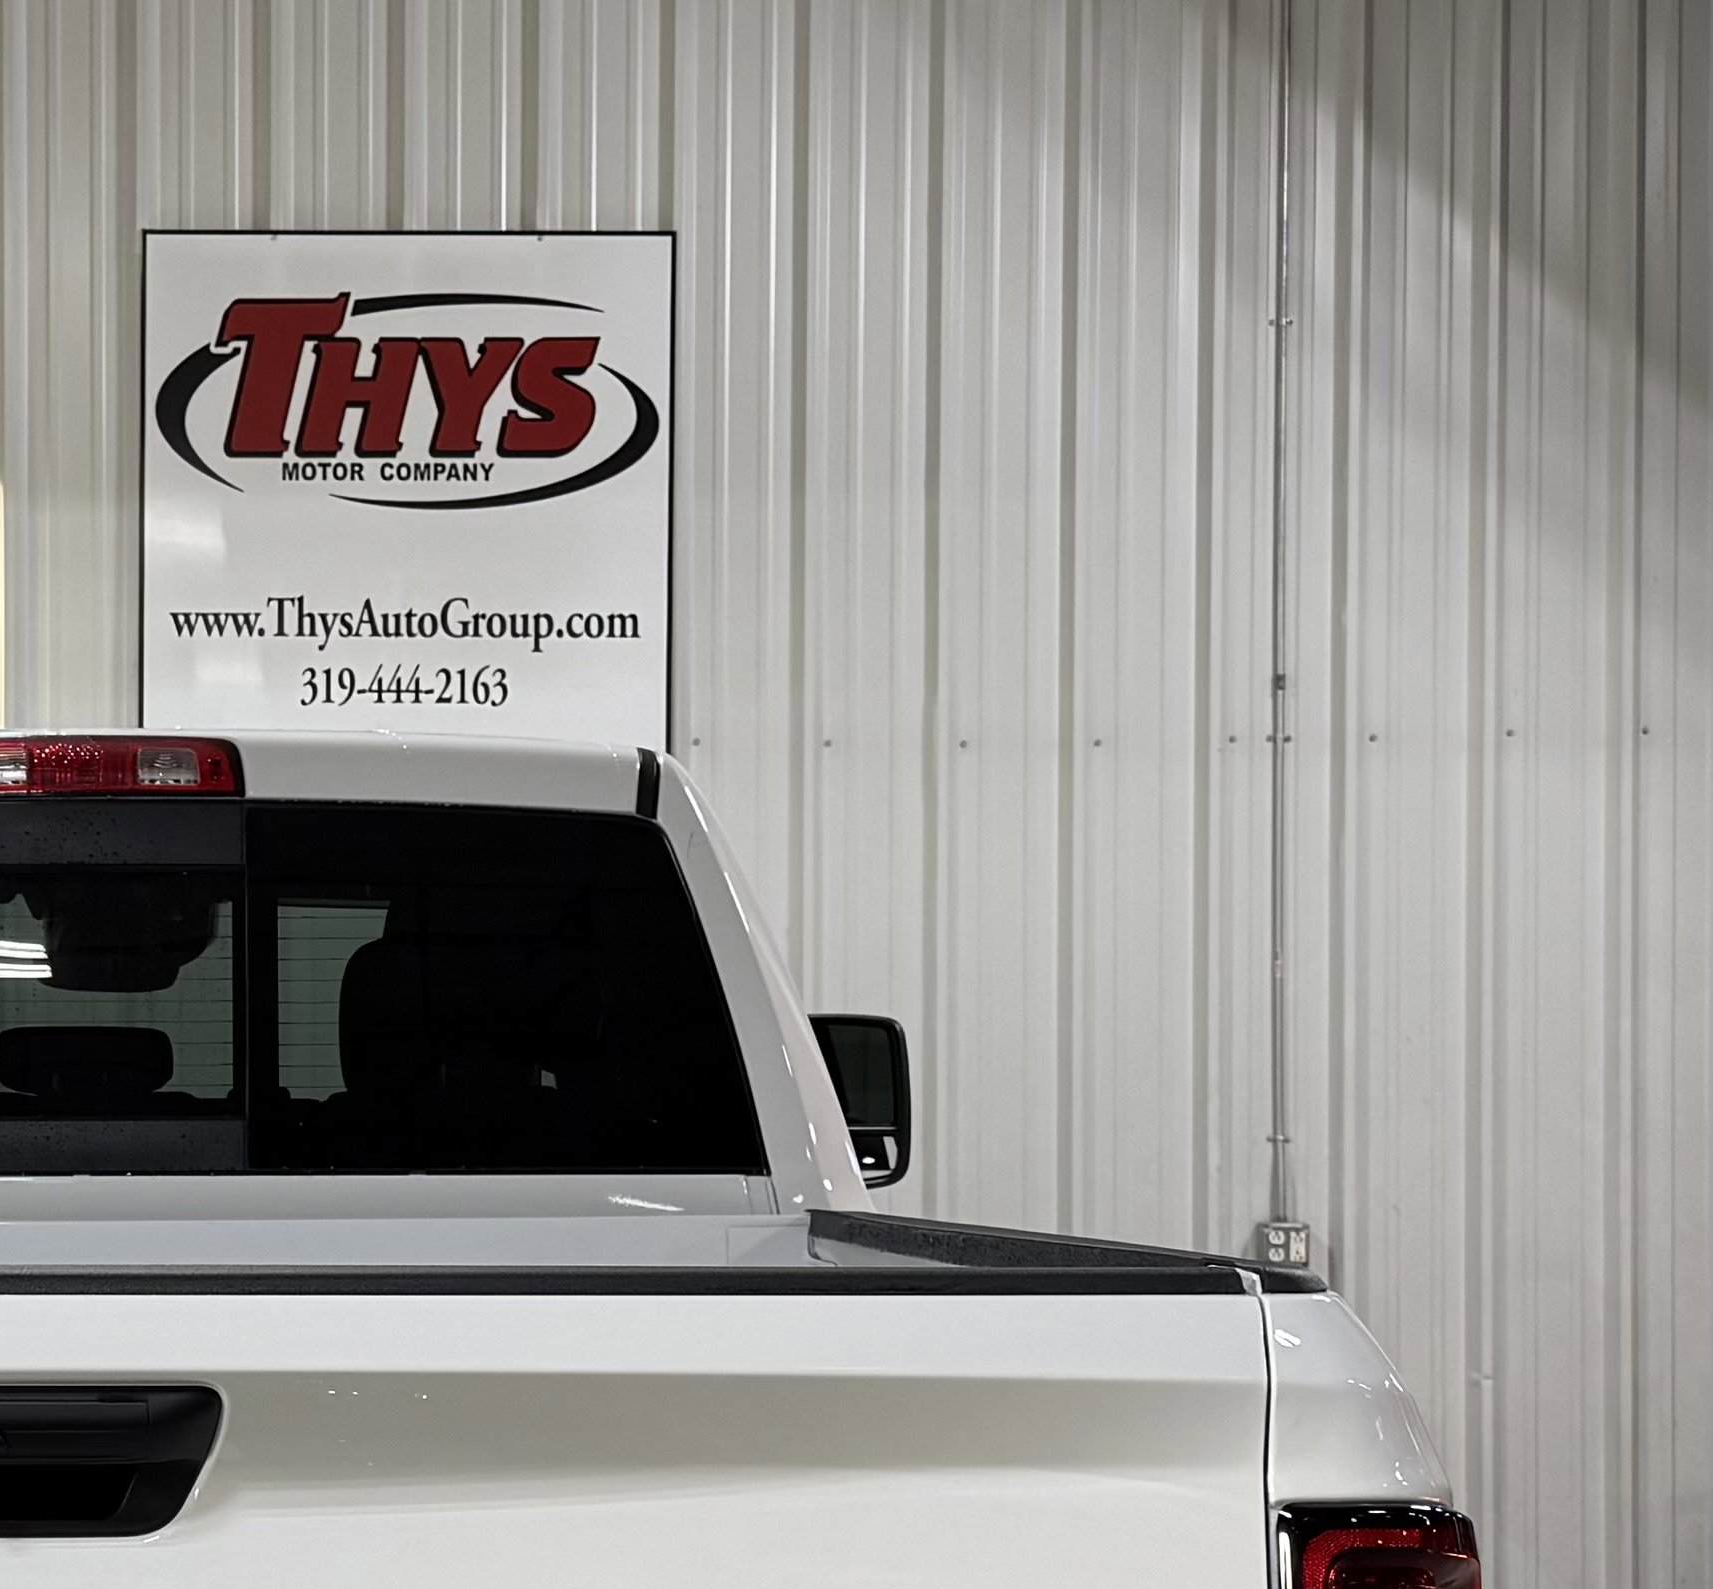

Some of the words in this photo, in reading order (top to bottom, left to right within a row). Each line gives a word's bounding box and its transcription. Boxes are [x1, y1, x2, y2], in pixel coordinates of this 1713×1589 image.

[281, 462, 366, 482] MOTOR
[379, 461, 495, 482] COMPANY
[170, 595, 641, 653] www.ThysAutoGroup.com
[300, 664, 509, 708] 319-444-2163
